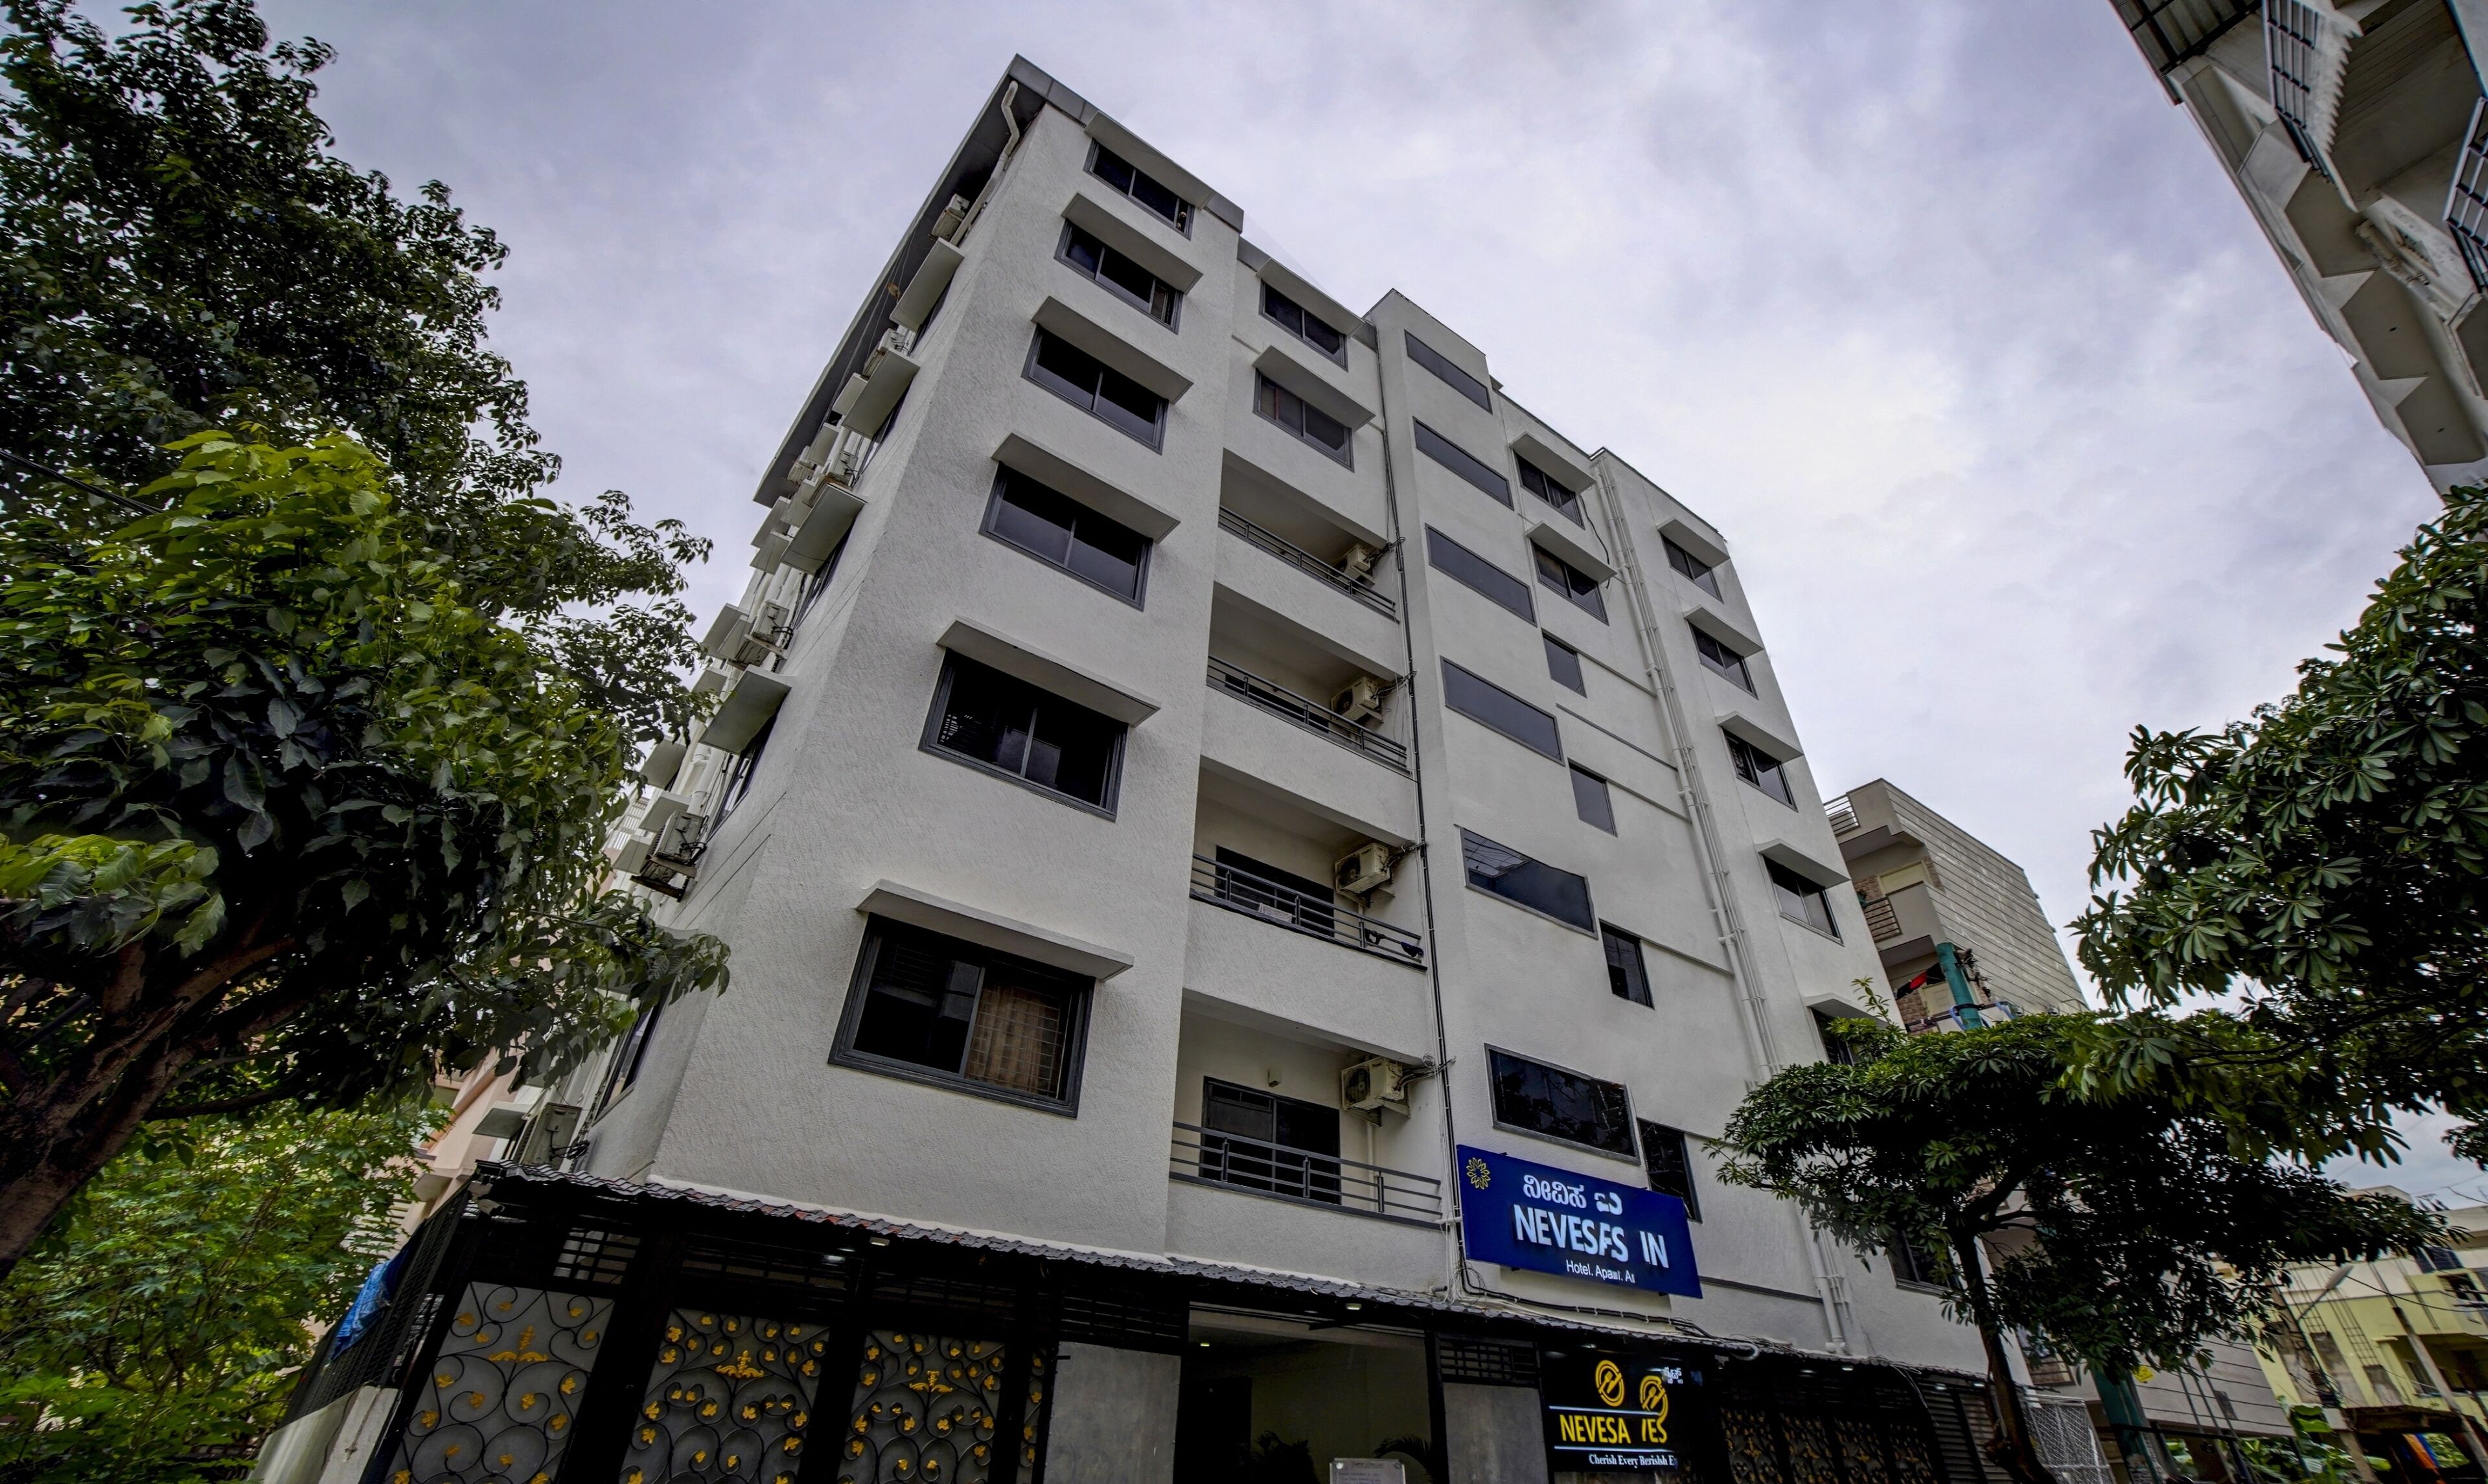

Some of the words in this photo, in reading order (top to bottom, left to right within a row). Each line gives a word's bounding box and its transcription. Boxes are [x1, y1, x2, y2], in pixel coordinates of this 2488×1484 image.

[1639, 1231, 1668, 1268] IN
[1560, 1414, 1631, 1444] NEVESA
[1589, 1454, 1617, 1465] Cherish
